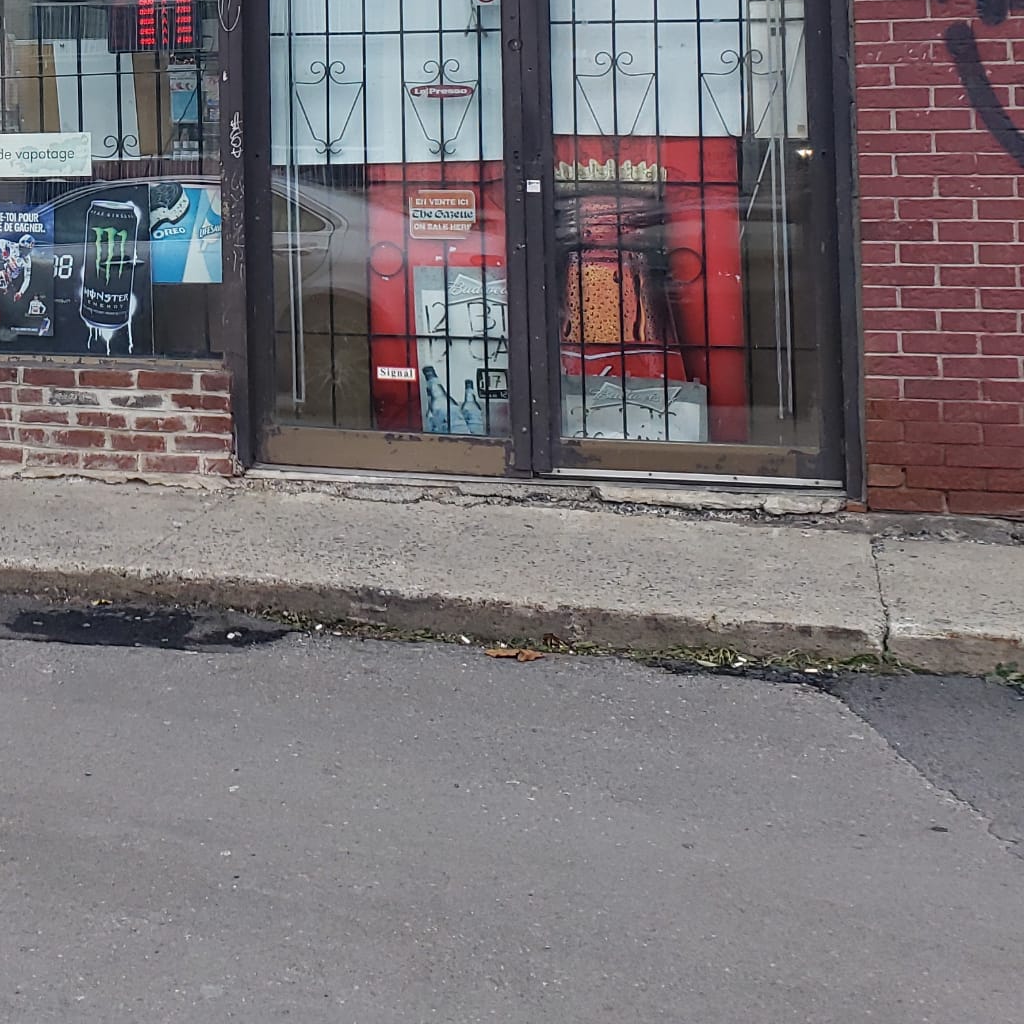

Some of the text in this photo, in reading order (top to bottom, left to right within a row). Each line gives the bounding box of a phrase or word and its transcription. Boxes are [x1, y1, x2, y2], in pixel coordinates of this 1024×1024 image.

[15, 148, 75, 163] vapotage
[18, 212, 39, 223] POUR
[4, 223, 13, 232] DE
[14, 223, 46, 233] GAGNER.
[152, 227, 186, 239] OREO
[379, 367, 414, 378] Signal
